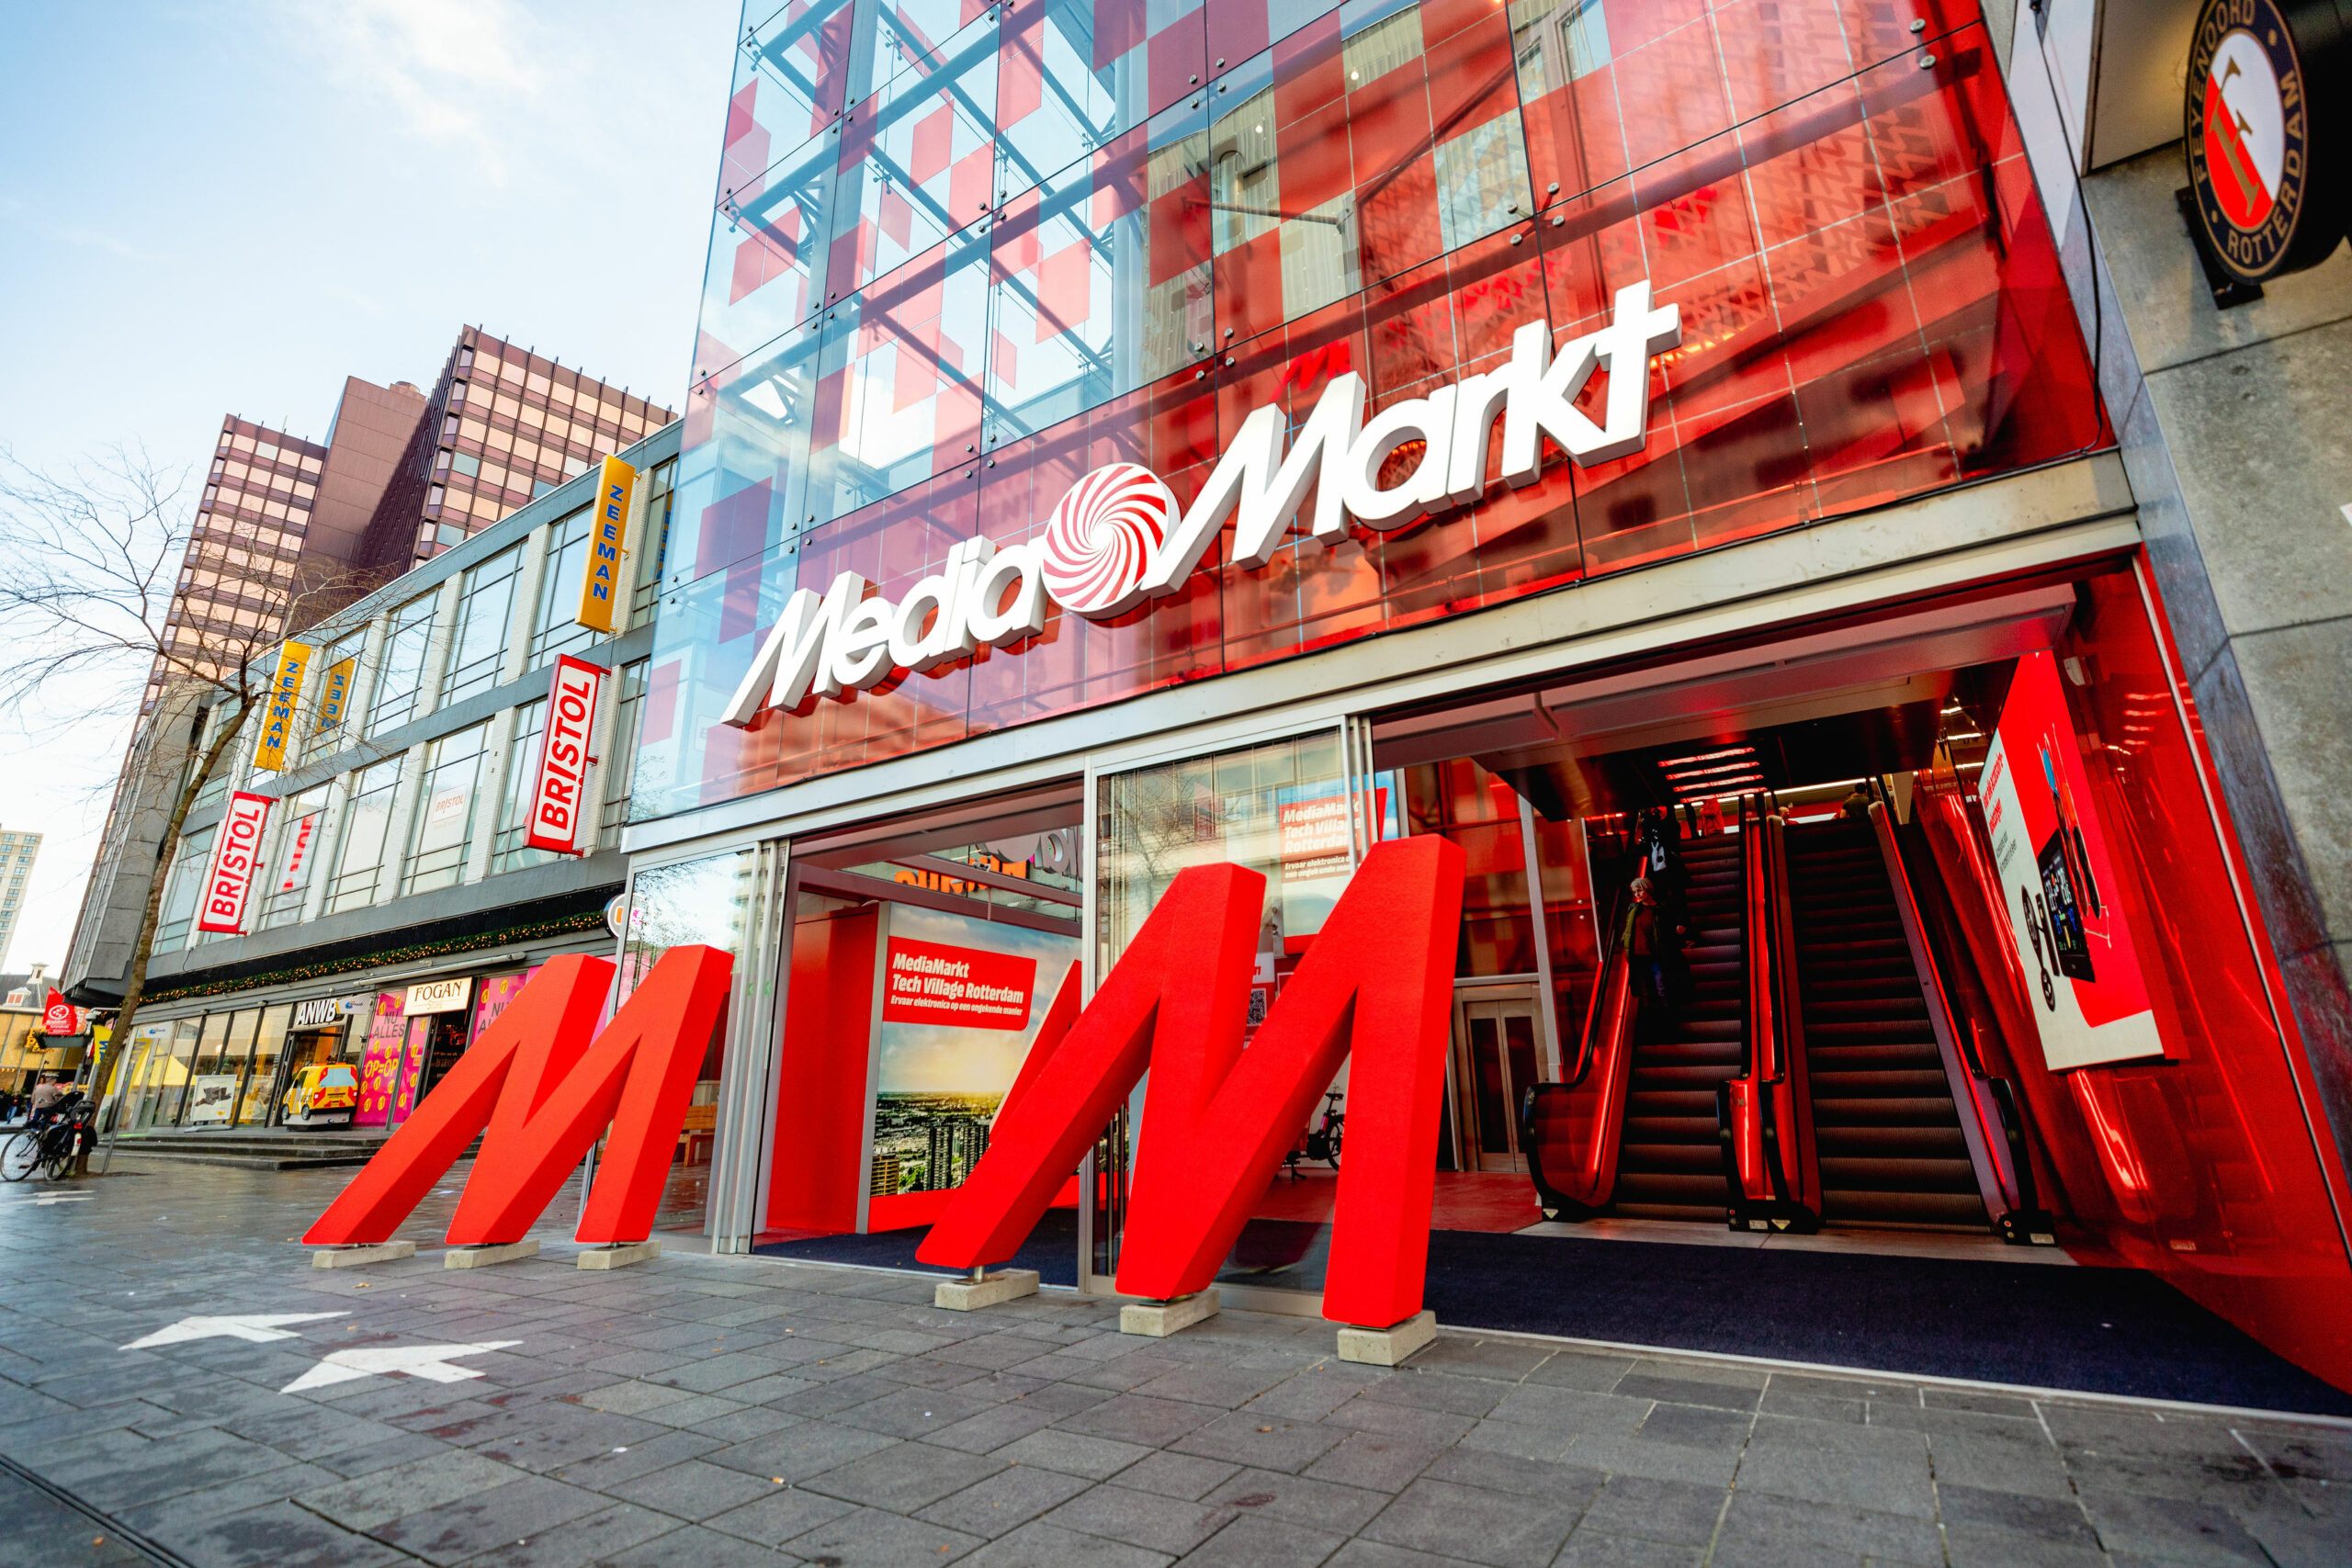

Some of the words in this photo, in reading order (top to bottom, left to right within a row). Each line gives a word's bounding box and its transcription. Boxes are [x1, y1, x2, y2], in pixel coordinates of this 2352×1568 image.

[2191, 0, 2256, 183] FEYENOORD
[2227, 71, 2304, 265] ROTTERDAM
[593, 484, 625, 601] ZEEMAN
[266, 661, 300, 749] ZEEMAN
[540, 682, 591, 830] BRISTOL
[435, 794, 464, 814] BRISTOL
[1284, 822, 1314, 840] Tech
[1315, 817, 1361, 834] Villae
[210, 808, 260, 918] BRISTOL
[891, 953, 970, 978] MediaMarkt
[414, 980, 463, 1002] FOGAN
[892, 974, 922, 993] Tech
[923, 977, 965, 999] Village
[965, 983, 1024, 1004] Rotterdam
[296, 998, 337, 1025] ANWB
[384, 1010, 400, 1024] NU
[890, 995, 914, 1006] Ervaar
[913, 997, 950, 1010] elektronica
[950, 1002, 959, 1011] op
[970, 1004, 1003, 1014] ongekende
[1002, 1007, 1023, 1016] manier
[372, 1023, 406, 1039] ALLES
[365, 1058, 400, 1077] OP=OP
